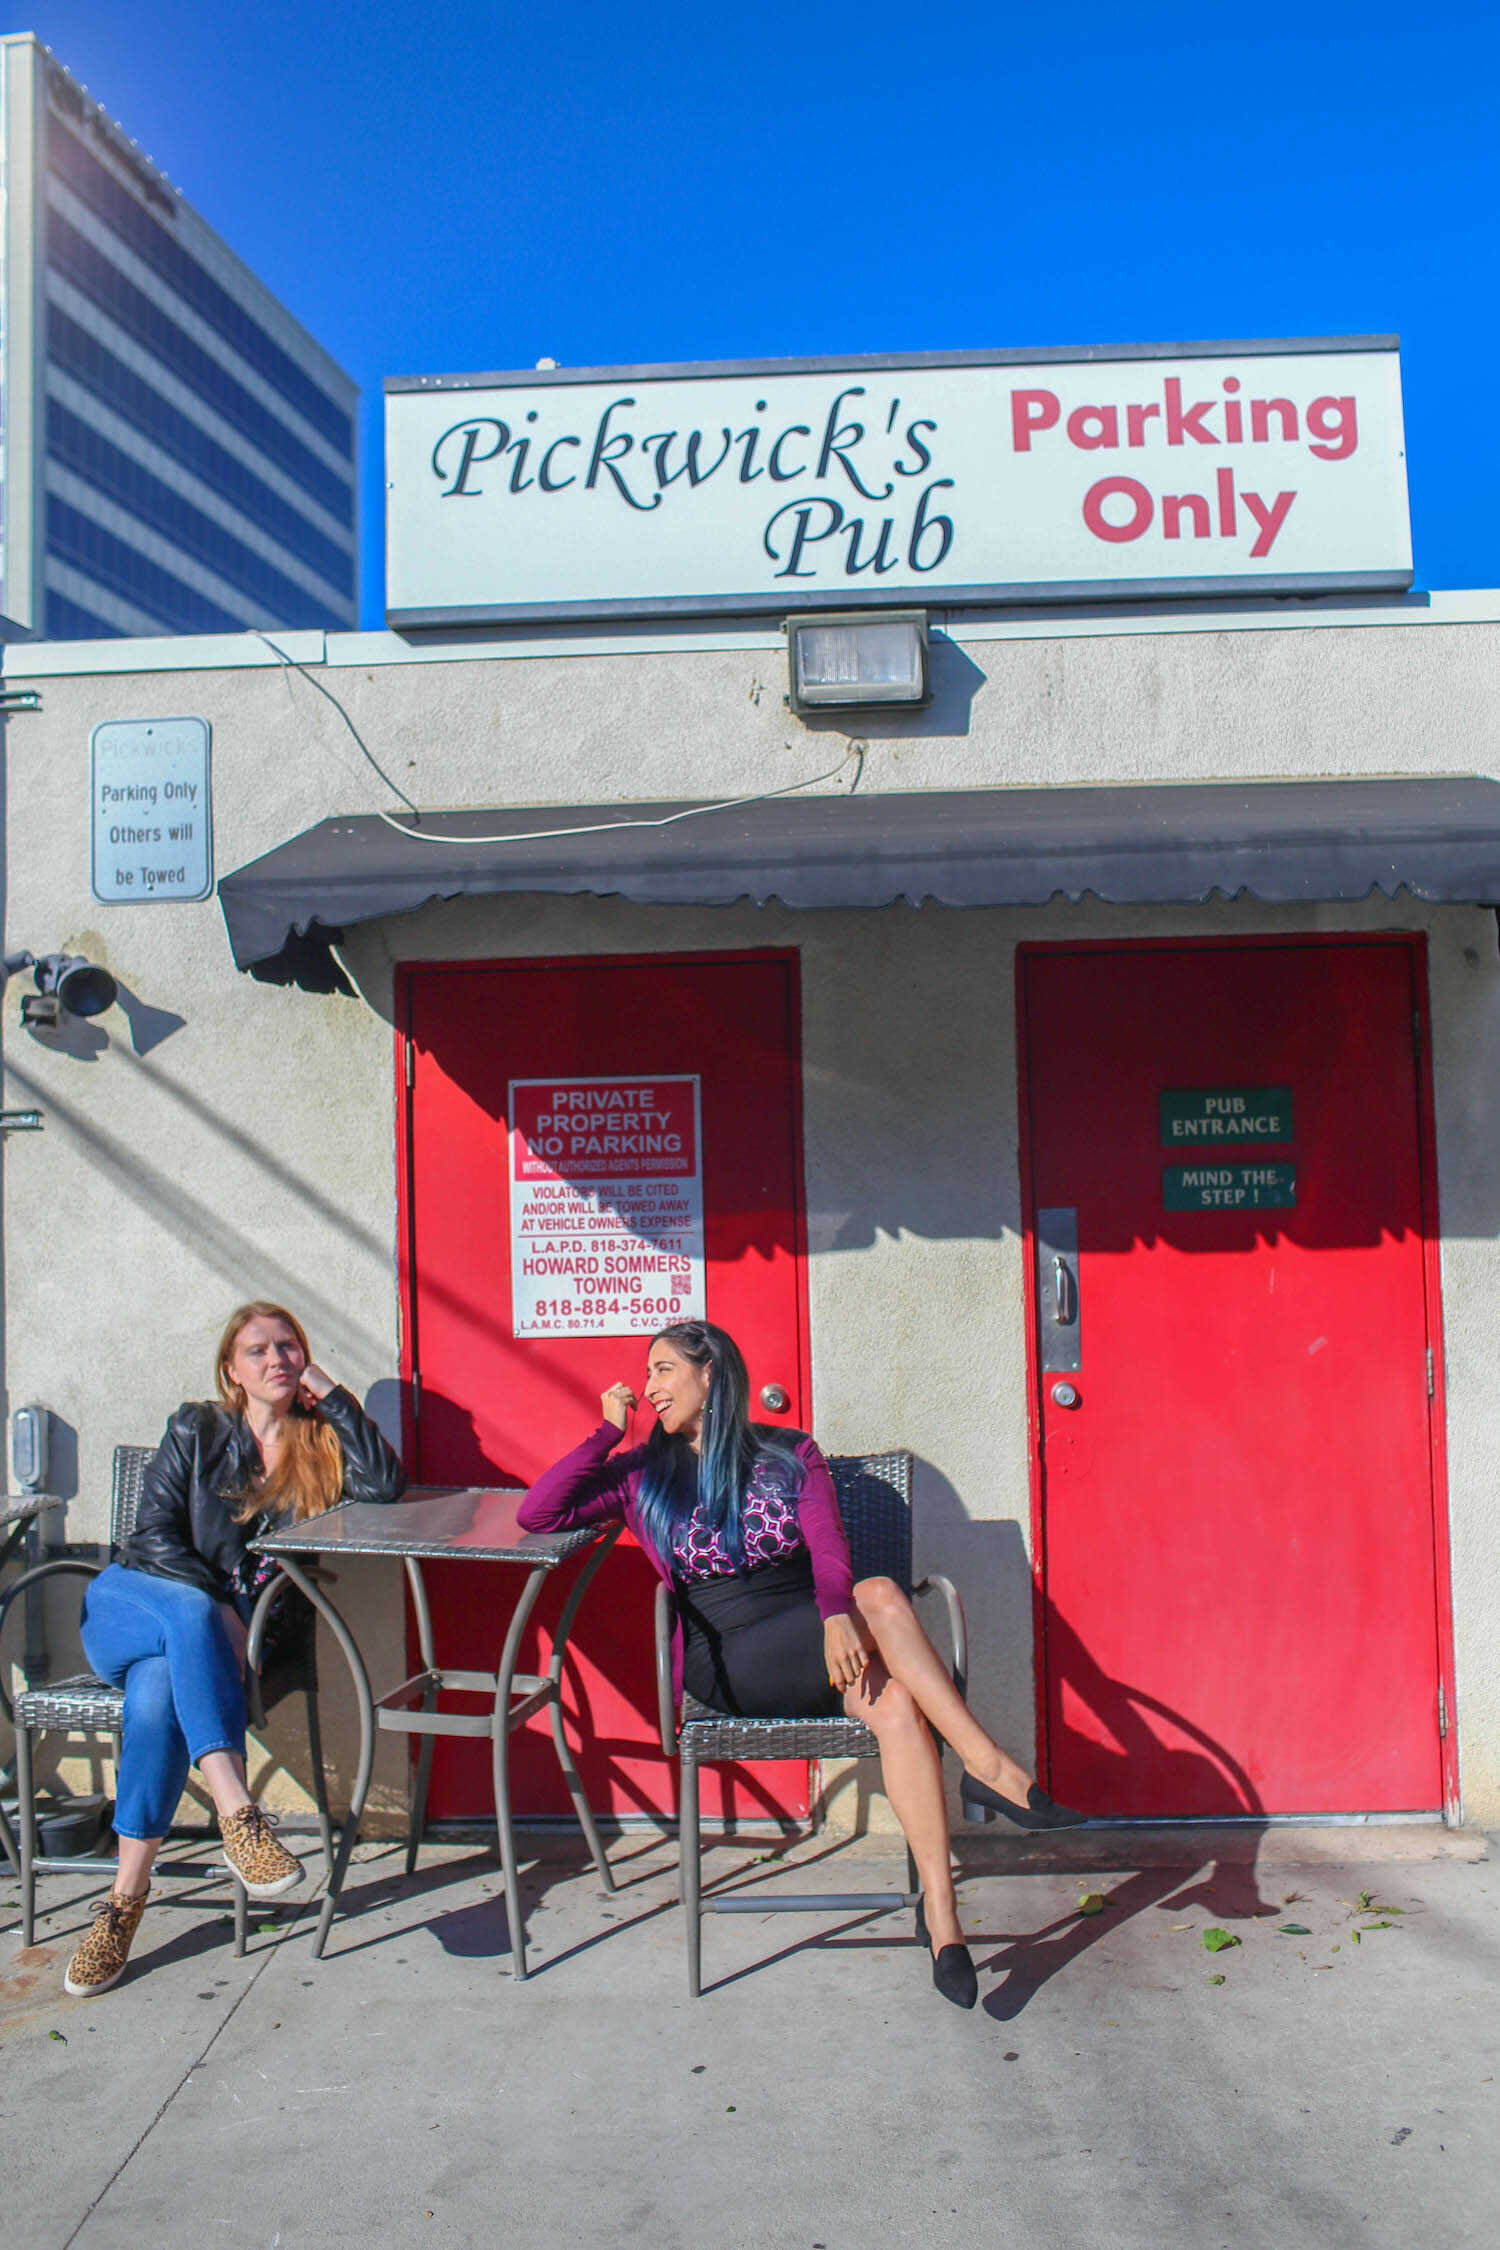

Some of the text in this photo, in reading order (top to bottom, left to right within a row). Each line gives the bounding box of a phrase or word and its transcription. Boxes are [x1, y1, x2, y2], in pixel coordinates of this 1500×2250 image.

[1010, 376, 1358, 461] Parking
[431, 387, 937, 510] Pickwick's
[1082, 467, 1298, 558] Only
[764, 478, 955, 578] Pub
[102, 782, 198, 805] Parking Only
[110, 824, 193, 844] Others will
[116, 867, 185, 885] be Towed
[553, 1089, 655, 1110] PRIVATE
[1205, 1097, 1246, 1114] PUB
[537, 1112, 671, 1133] PROPERTY
[1172, 1116, 1281, 1136] ENTRANCE
[528, 1134, 682, 1156] NO PARKING
[1182, 1169, 1278, 1187] MIND THE
[533, 1184, 678, 1199] VIOLATORS WILL BE CITED
[1201, 1188, 1246, 1205] STEP
[523, 1200, 689, 1215] AND/OR WILL BE TOWED AWAY
[521, 1219, 536, 1231] AT
[538, 1218, 585, 1231] VEHICLE
[641, 1216, 691, 1228] EXPENSE
[532, 1239, 682, 1254] L.A.P.D. 818-374-7611
[523, 1255, 691, 1276] HOWARD SOMMERS
[573, 1276, 642, 1294] TOWING
[536, 1298, 681, 1316] 818-884-5600
[521, 1320, 565, 1330] L.A.M.C.
[630, 1317, 662, 1328] C.V.C.
